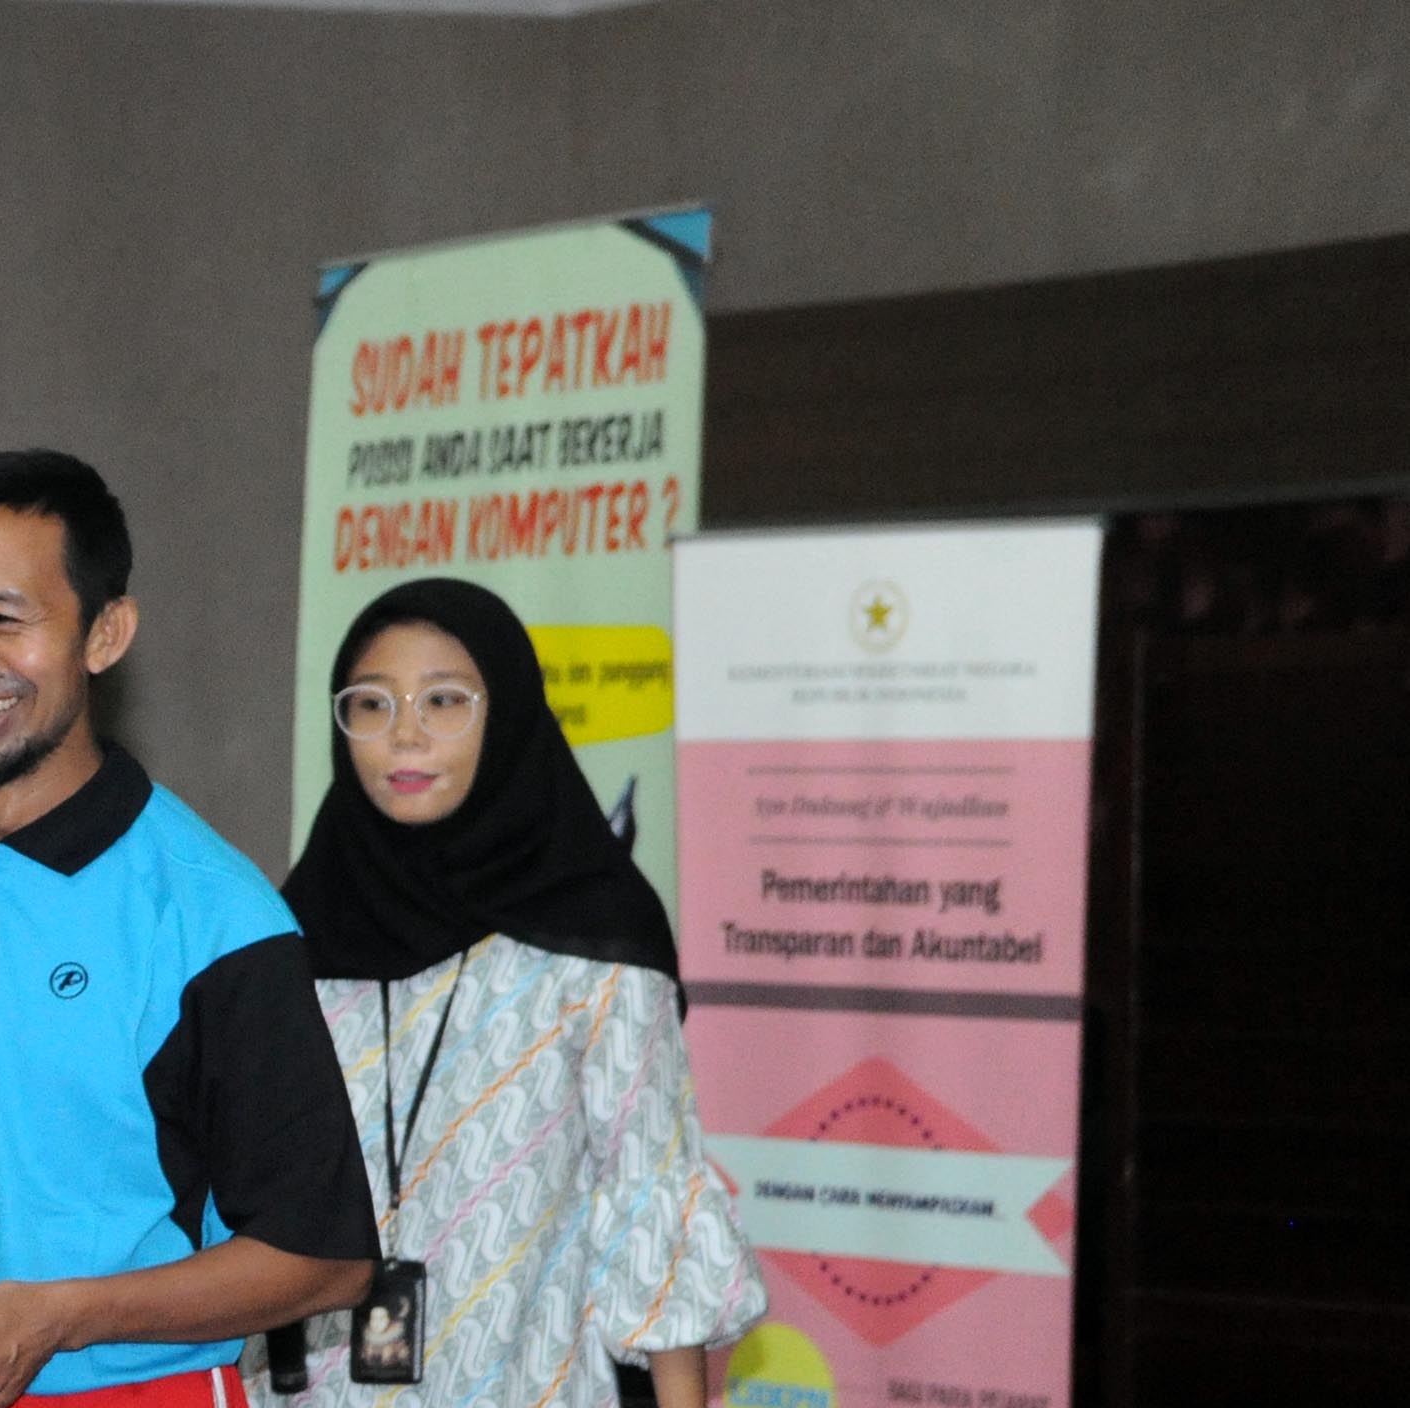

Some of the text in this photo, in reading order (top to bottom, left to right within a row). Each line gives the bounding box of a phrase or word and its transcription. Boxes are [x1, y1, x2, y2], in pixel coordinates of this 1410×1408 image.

[351, 300, 673, 417] SUDAH TEPATKAH
[419, 430, 481, 478] ANDA
[559, 408, 665, 469] BEKERJA
[336, 499, 458, 573] DENGAN
[466, 479, 650, 564] KOMPUTER
[761, 869, 1001, 915] Pemerintahan yang
[722, 920, 1043, 963] Transparan dan Akuntabel
